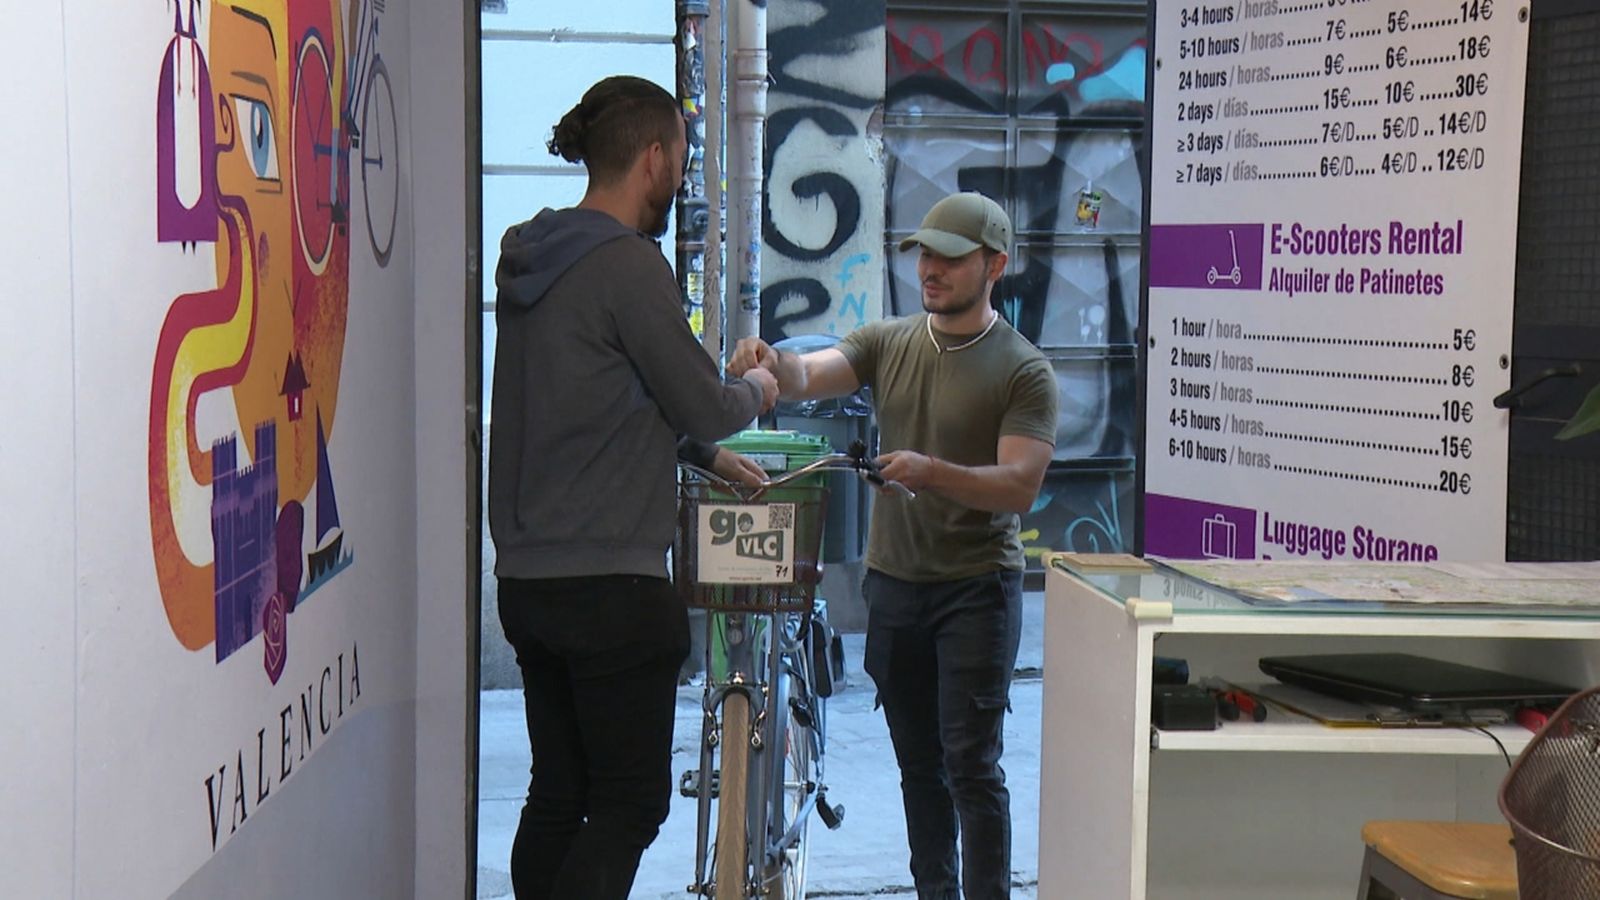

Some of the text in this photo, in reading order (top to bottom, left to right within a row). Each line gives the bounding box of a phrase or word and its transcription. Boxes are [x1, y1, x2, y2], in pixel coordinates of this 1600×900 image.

[1180, 38, 1204, 59] 5-10
[1208, 36, 1239, 56] hours
[1251, 31, 1284, 51] horas
[1326, 19, 1346, 41] 7€
[1387, 10, 1409, 33] 5€
[1460, 0, 1493, 23] 14€
[1181, 7, 1199, 28] 3-4
[1202, 5, 1234, 25] hours
[1244, 0, 1278, 19] horas
[1178, 70, 1192, 90] 24
[1195, 69, 1227, 89] hours
[1237, 65, 1270, 85] horas
[1324, 53, 1345, 76] 9€
[1386, 46, 1408, 69] 6€
[1458, 35, 1491, 60] 18€
[1178, 102, 1185, 121] 2
[1188, 101, 1213, 124] days
[1224, 97, 1248, 118] días
[1324, 87, 1351, 110] 15€
[1385, 81, 1415, 104] 10€
[1456, 73, 1488, 98] 30€
[1197, 132, 1223, 154] days
[1234, 128, 1259, 149] días
[1322, 121, 1355, 143] 7€/D
[1383, 116, 1419, 139] 5€/D
[1439, 110, 1487, 135] 14€/D
[1196, 163, 1222, 186] days
[1233, 160, 1258, 181] días
[1320, 156, 1354, 178] 6€/D
[1381, 152, 1417, 174] 4€/D
[1437, 147, 1485, 171] 12€/D
[1271, 219, 1463, 256] E-Scooters Rental
[1269, 267, 1444, 298] Alquiler de Patinetes
[1172, 317, 1178, 336] 1
[1182, 317, 1206, 337] hour
[1216, 319, 1242, 339] hora
[1453, 329, 1476, 351] 5€
[1171, 347, 1178, 366] 2
[1181, 348, 1211, 369] hours
[1221, 350, 1254, 372] horas
[1452, 364, 1475, 387] 8€
[1170, 378, 1177, 397] 3
[1180, 378, 1211, 400] hours
[1220, 382, 1253, 403] horas
[1442, 400, 1474, 423] 10€
[1169, 408, 1188, 428] 4-5
[1190, 409, 1221, 432] hours
[1231, 414, 1264, 437] horas
[1441, 435, 1472, 459] 15€
[1169, 438, 1193, 459] 6-10
[1196, 441, 1227, 463] hours
[1238, 446, 1271, 469] horas
[1440, 470, 1471, 495] 20€
[742, 535, 777, 557] VLC
[1263, 511, 1346, 560] Luggage
[776, 565, 788, 577] 71
[205, 640, 360, 853] VALENCIA
